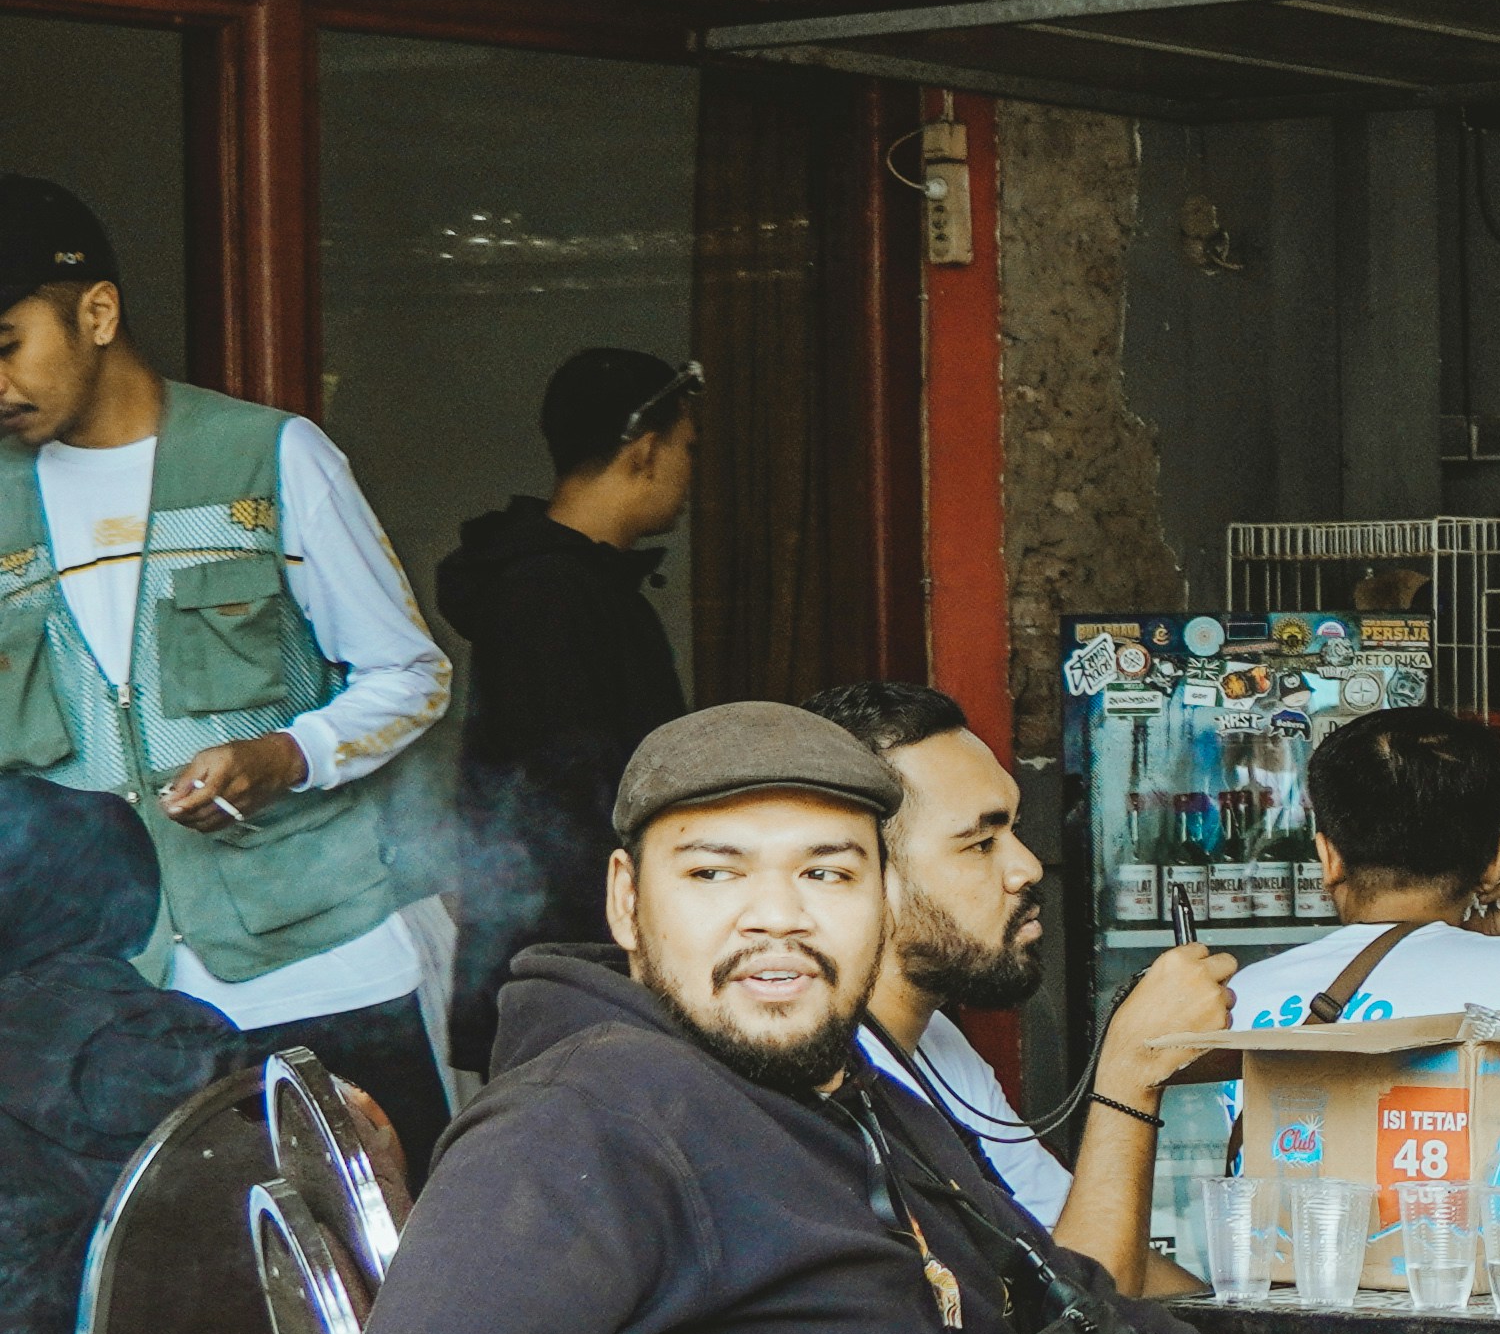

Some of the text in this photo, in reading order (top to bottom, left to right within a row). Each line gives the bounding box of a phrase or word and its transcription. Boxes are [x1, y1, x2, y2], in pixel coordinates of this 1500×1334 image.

[1361, 626, 1430, 642] PERSIJA
[1356, 653, 1429, 666] RETORIKA
[1383, 1109, 1468, 1132] ISI TETAP
[1278, 1128, 1317, 1153] Club
[1393, 1138, 1449, 1179] 48
